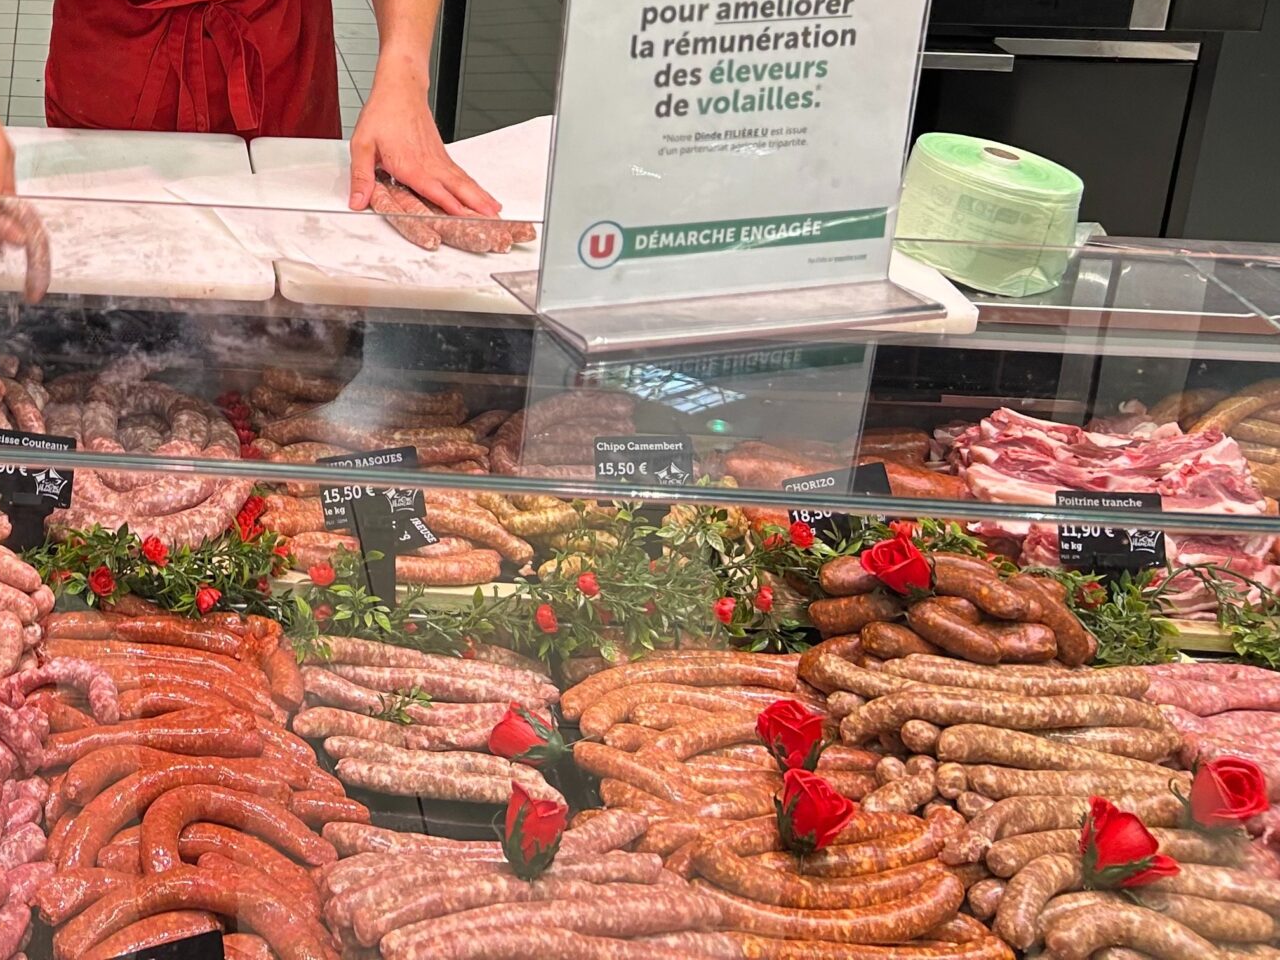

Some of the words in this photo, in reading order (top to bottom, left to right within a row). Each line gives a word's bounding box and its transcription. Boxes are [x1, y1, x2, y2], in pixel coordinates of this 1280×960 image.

[641, 3, 710, 32] pour
[630, 35, 654, 59] la
[663, 23, 857, 57] rémunération
[654, 64, 702, 87] des
[709, 59, 828, 84] éleveurs
[655, 94, 689, 118] de
[695, 131, 722, 141] Dinde
[589, 233, 615, 259] U
[634, 227, 737, 250] DÉMARCHE
[739, 217, 823, 242] ENGAGÉE
[21, 437, 70, 452] Couteaux
[596, 442, 626, 453] Chipo
[627, 441, 684, 452] Camembert
[355, 453, 403, 468] BASQUES
[599, 462, 635, 477] 15,50
[639, 462, 648, 475] €
[785, 477, 835, 493] CHORIZO
[323, 485, 362, 504] 15,50
[365, 485, 376, 497] €
[1058, 495, 1100, 506] Poitrine
[1101, 498, 1143, 507] tranche
[324, 508, 333, 516] le
[334, 506, 346, 517] kg
[1061, 524, 1101, 539] 11,90
[1104, 527, 1115, 538] €
[1061, 541, 1070, 550] le
[1071, 541, 1083, 552] kg
